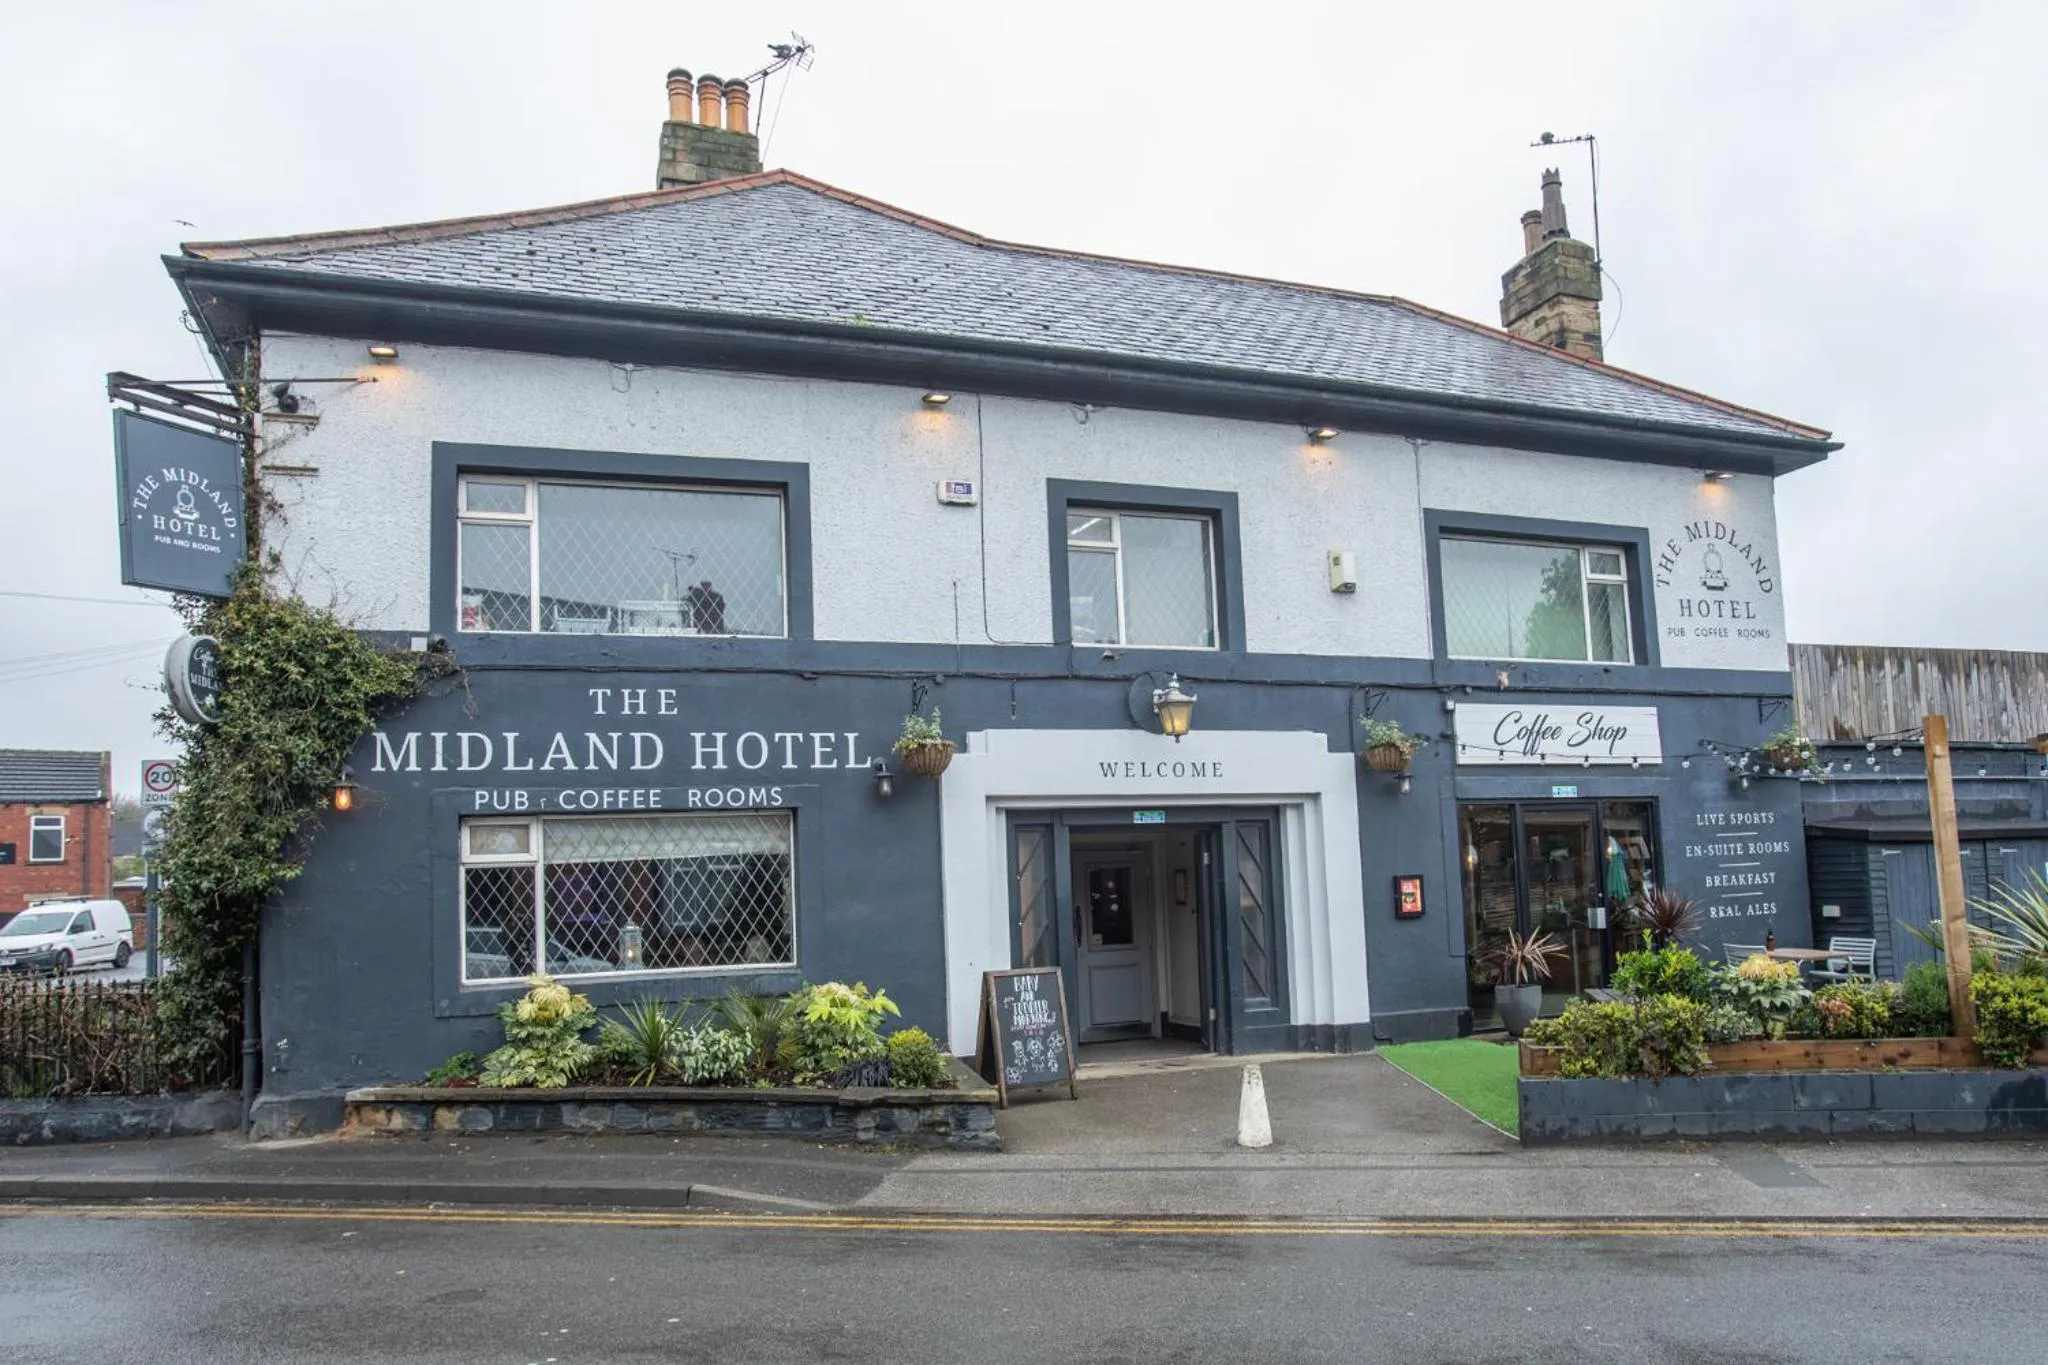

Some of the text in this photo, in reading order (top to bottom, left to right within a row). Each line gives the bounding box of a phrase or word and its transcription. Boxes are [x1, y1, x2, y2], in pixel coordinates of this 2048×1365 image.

[133, 467, 236, 528] THE MIDLAND
[153, 515, 221, 541] HOTEL
[154, 534, 221, 553] PUB AND ROOMS
[1656, 520, 1773, 593] THE MIDLAND
[1678, 598, 1756, 619] HOTEL
[1667, 627, 1770, 639] PUB COFFEE ROOMS
[589, 688, 678, 715] THE
[1493, 710, 1628, 756] Coffee Shop
[370, 731, 872, 772] MIDLAND HOTEL
[151, 771, 172, 783] 20
[1098, 760, 1223, 778] WELCOME
[474, 787, 783, 810] PUB COFFEE ROOMS
[1696, 812, 1775, 826] LIVE SPORTS
[1685, 841, 1790, 858] EN-SUITE ROOMS
[1705, 872, 1776, 888] BREAKFAST
[1710, 902, 1777, 918] REAL ALES
